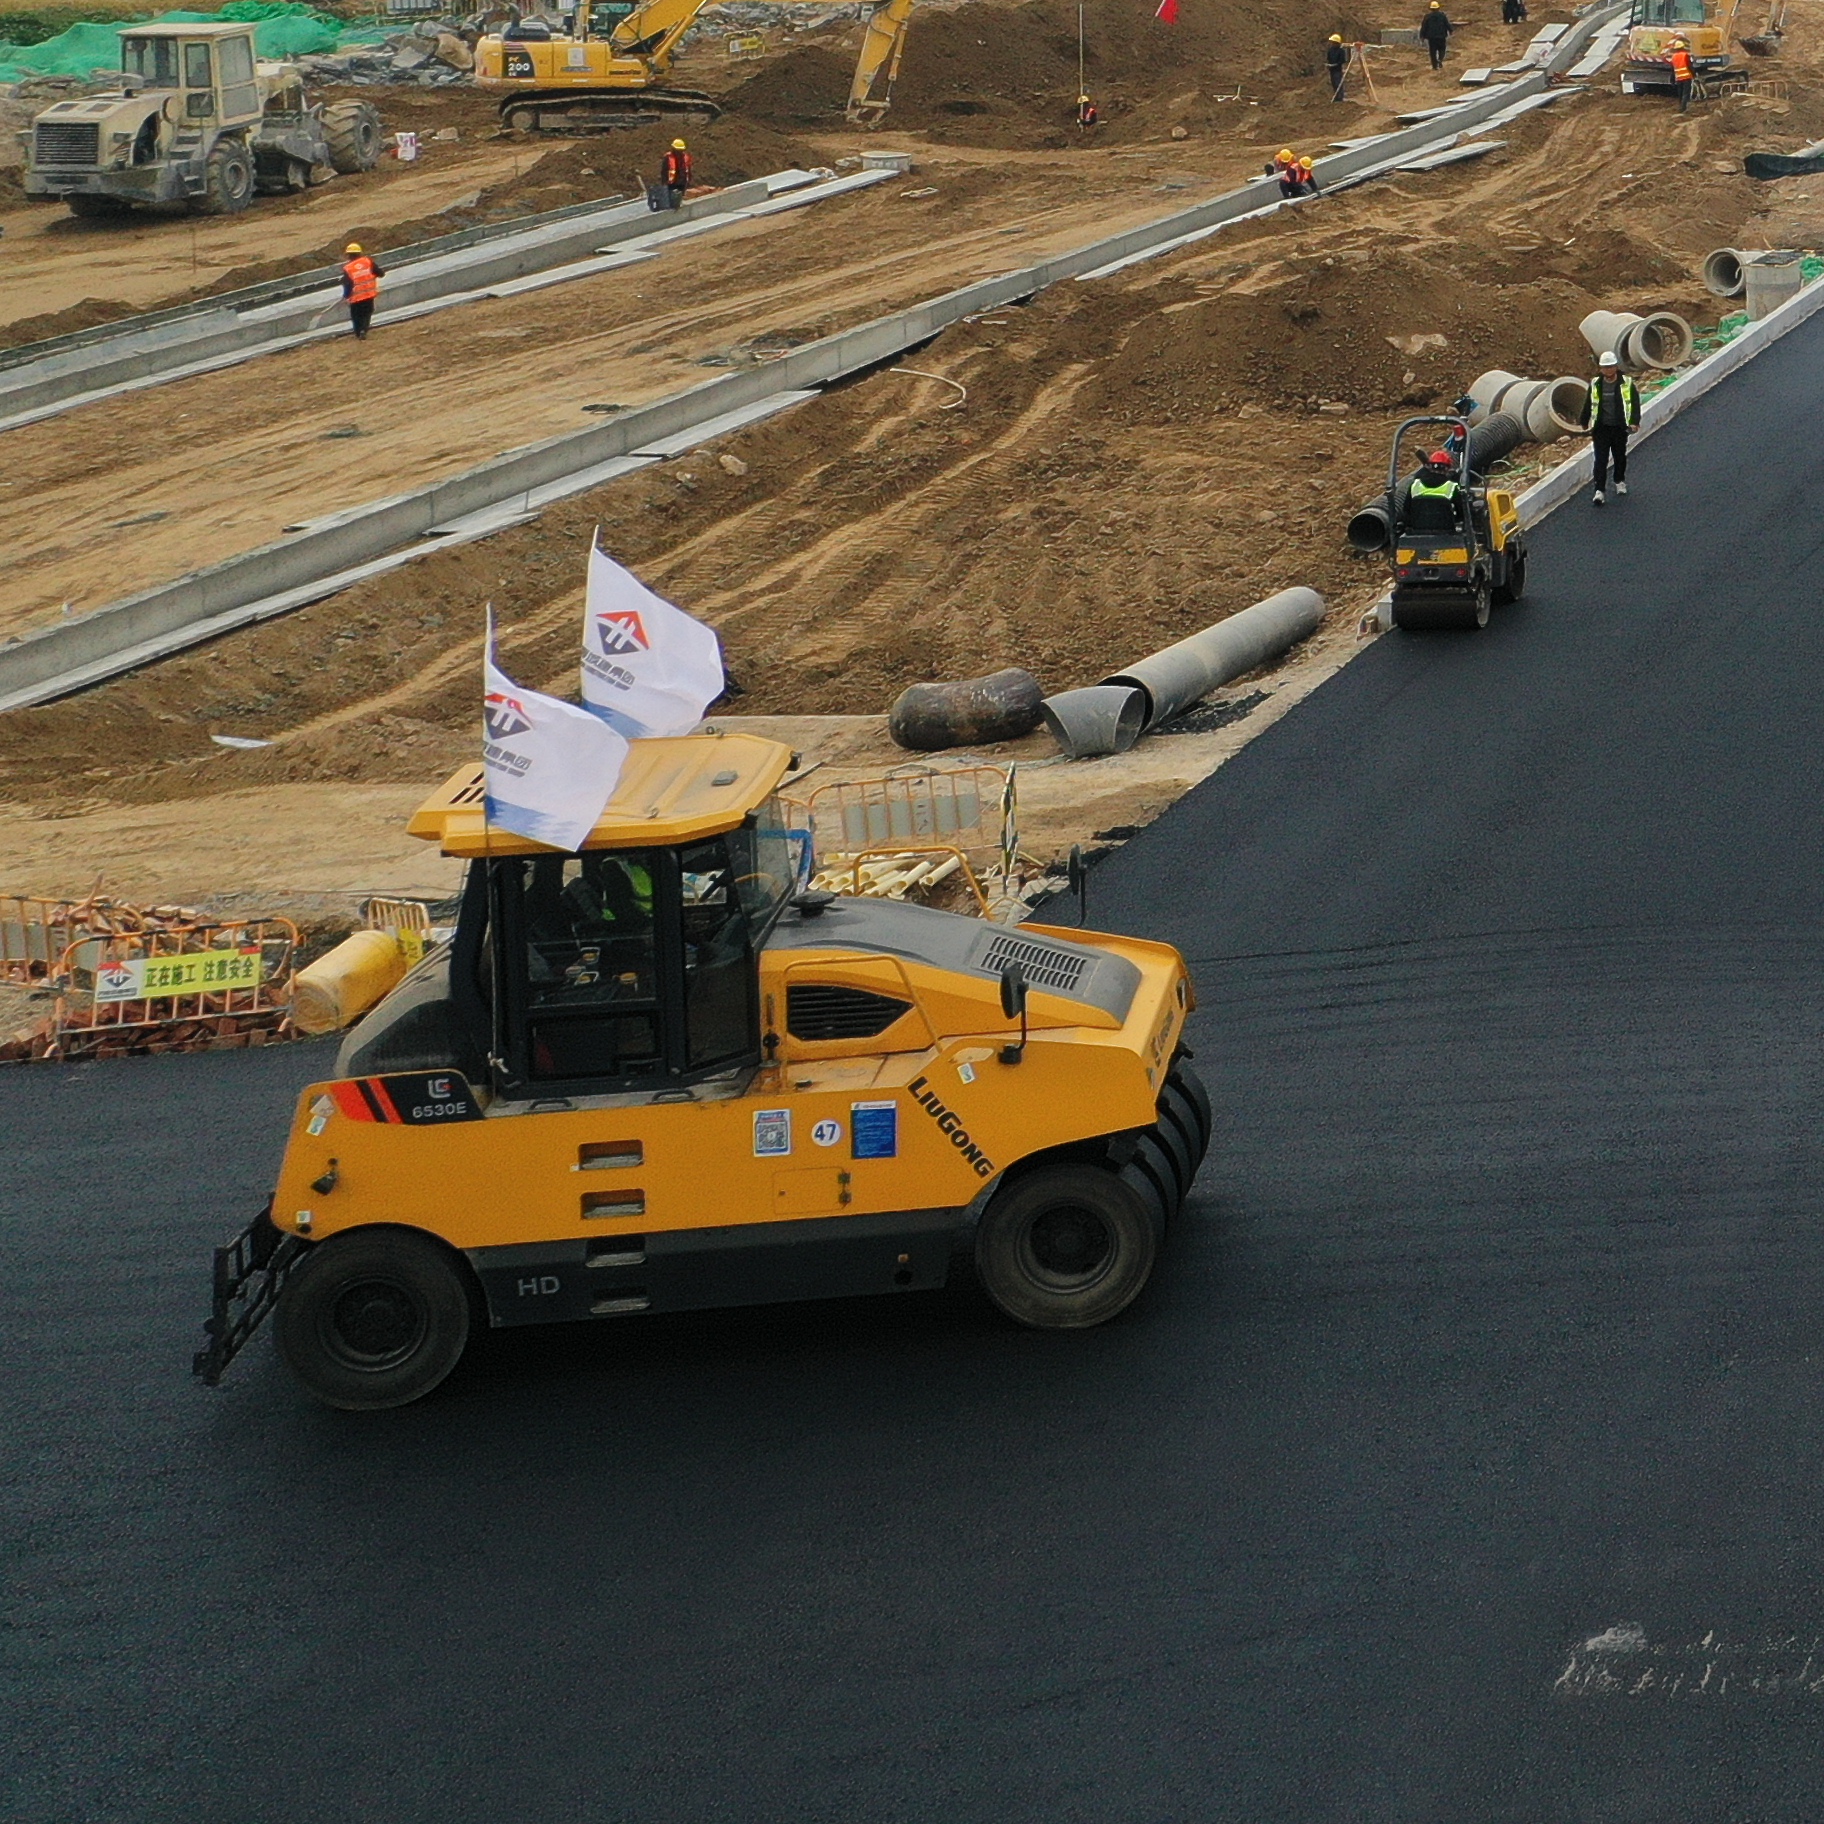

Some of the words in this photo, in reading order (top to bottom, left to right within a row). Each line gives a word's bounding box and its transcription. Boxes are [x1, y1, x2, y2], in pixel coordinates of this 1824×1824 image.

[508, 63, 530, 71] 200
[145, 963, 196, 988] 正在施工
[201, 953, 254, 982] 注意安全
[412, 1101, 468, 1119] 6530E
[814, 1123, 837, 1142] 47
[517, 1276, 560, 1296] HD
